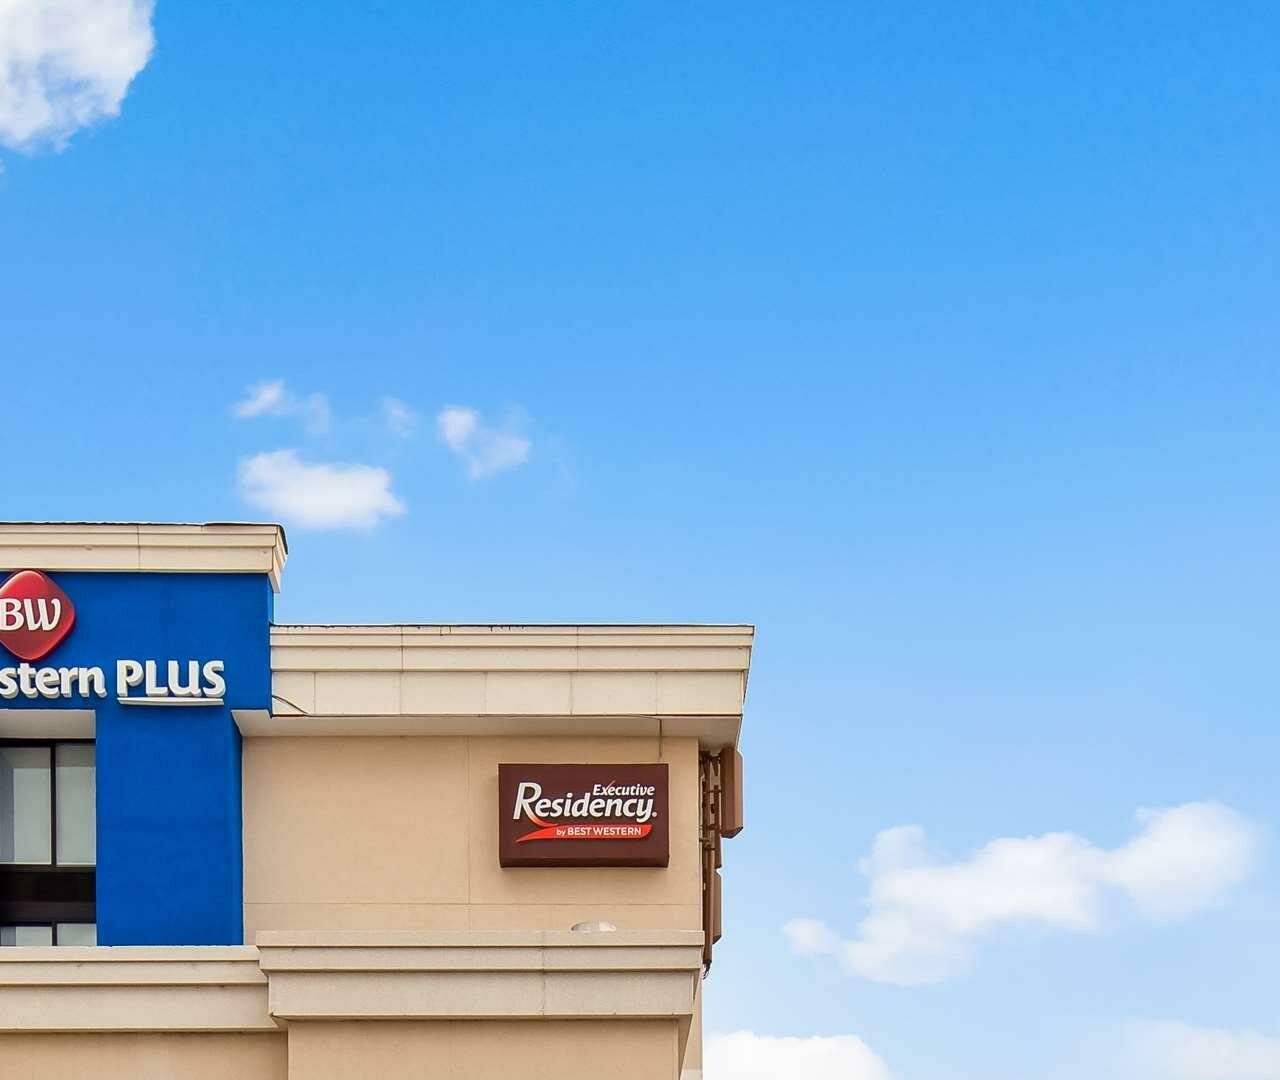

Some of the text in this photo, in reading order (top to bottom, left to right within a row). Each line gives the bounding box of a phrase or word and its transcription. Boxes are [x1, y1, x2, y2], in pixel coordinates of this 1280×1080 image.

[116, 659, 227, 699] PLUS
[593, 783, 656, 797] Executive
[556, 827, 642, 837] by BEST WESTERN
